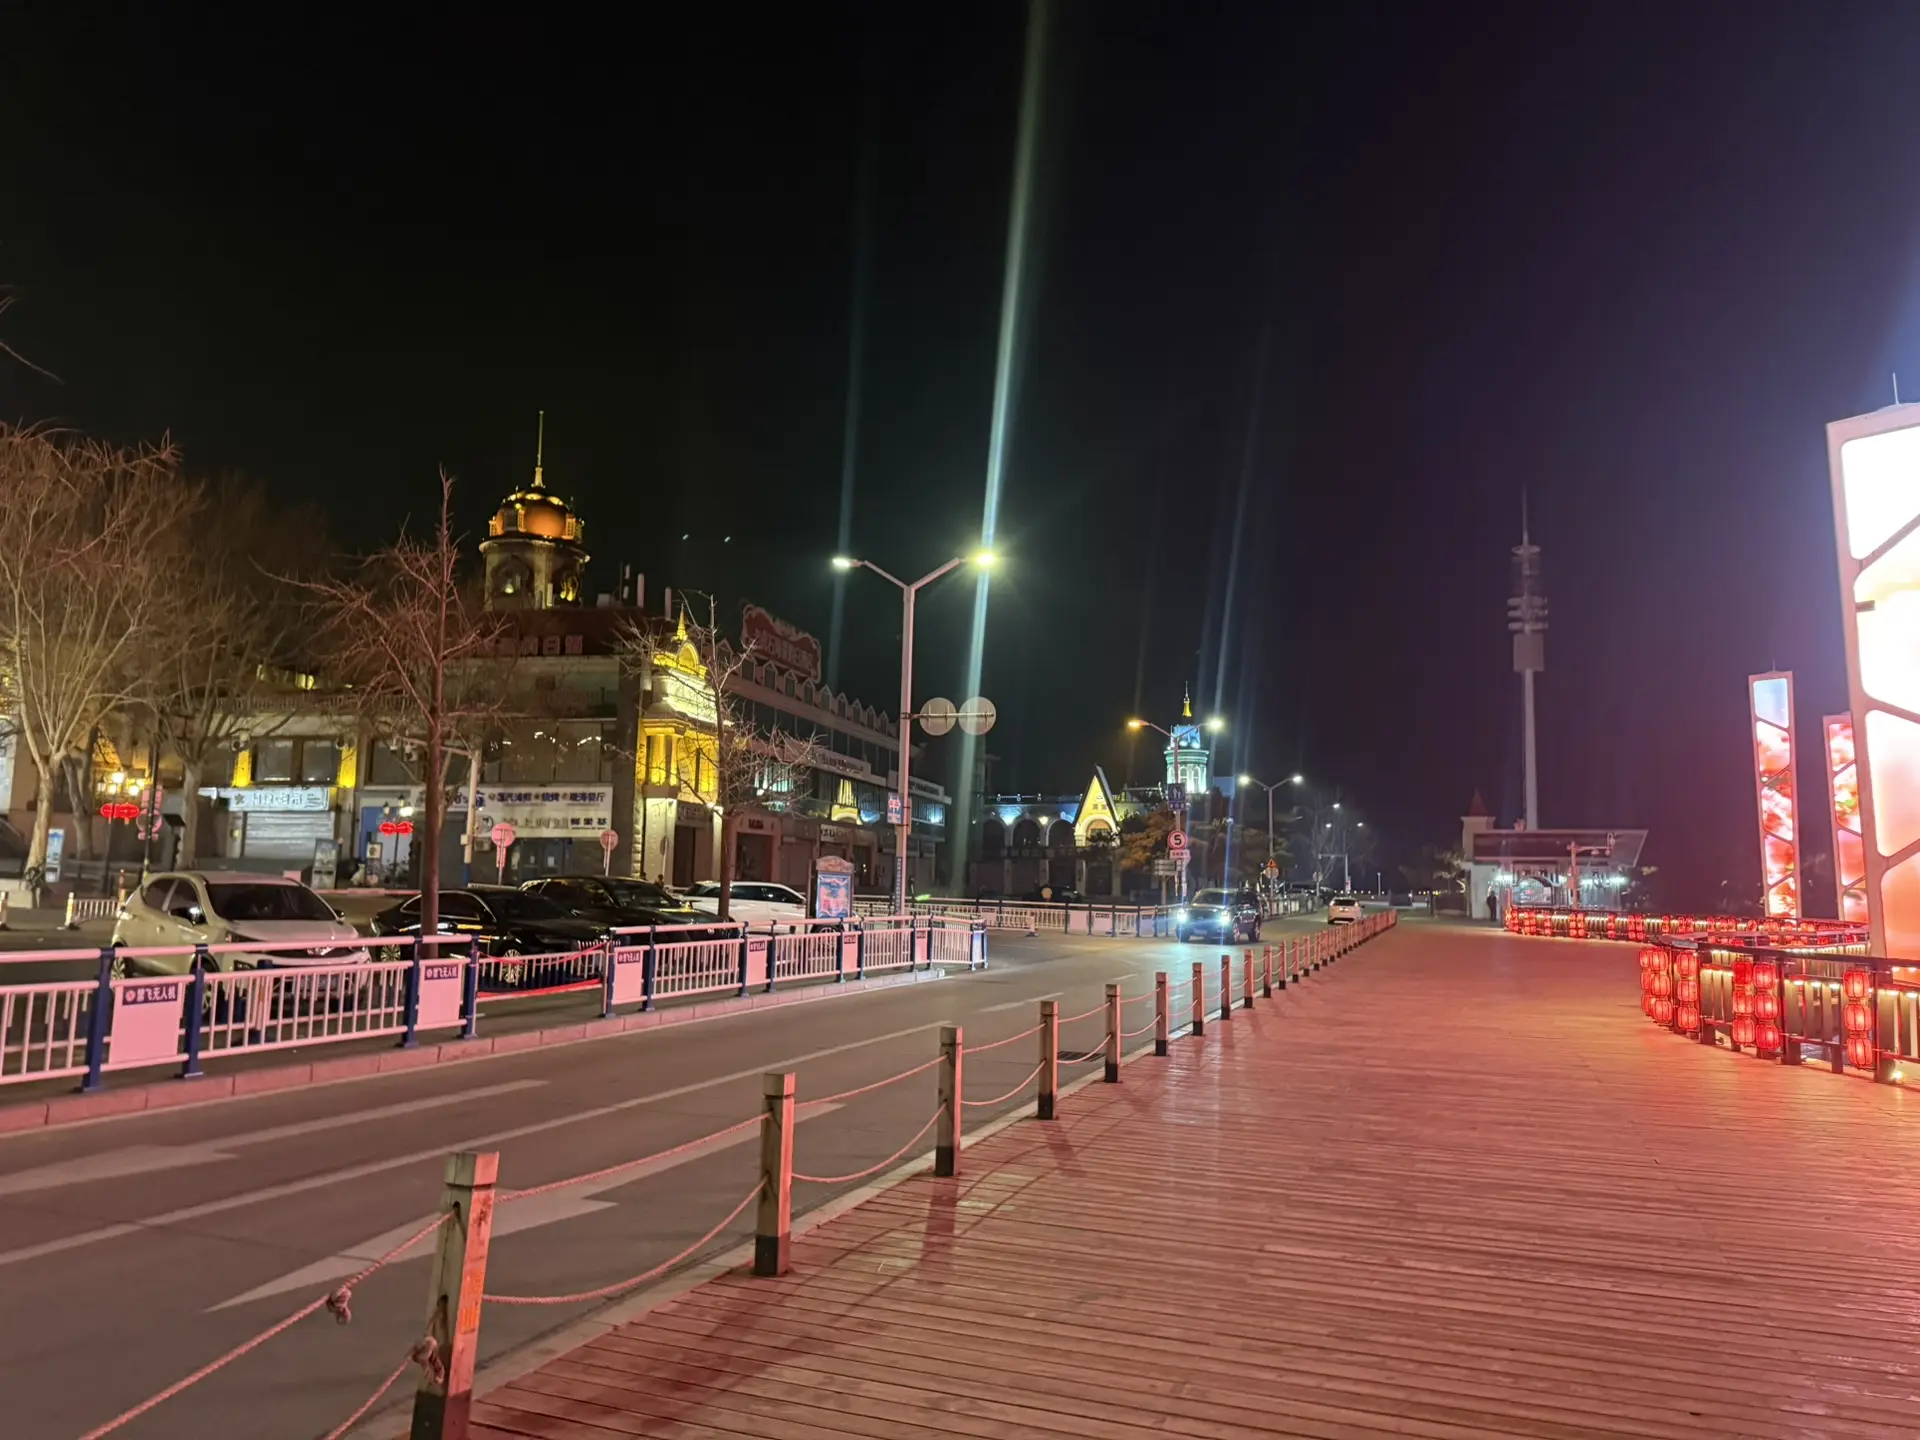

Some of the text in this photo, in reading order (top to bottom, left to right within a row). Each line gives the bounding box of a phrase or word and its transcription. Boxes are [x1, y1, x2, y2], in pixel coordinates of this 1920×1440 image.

[1174, 834, 1182, 846] 5
[136, 985, 176, 1002] 禁飞无人机
